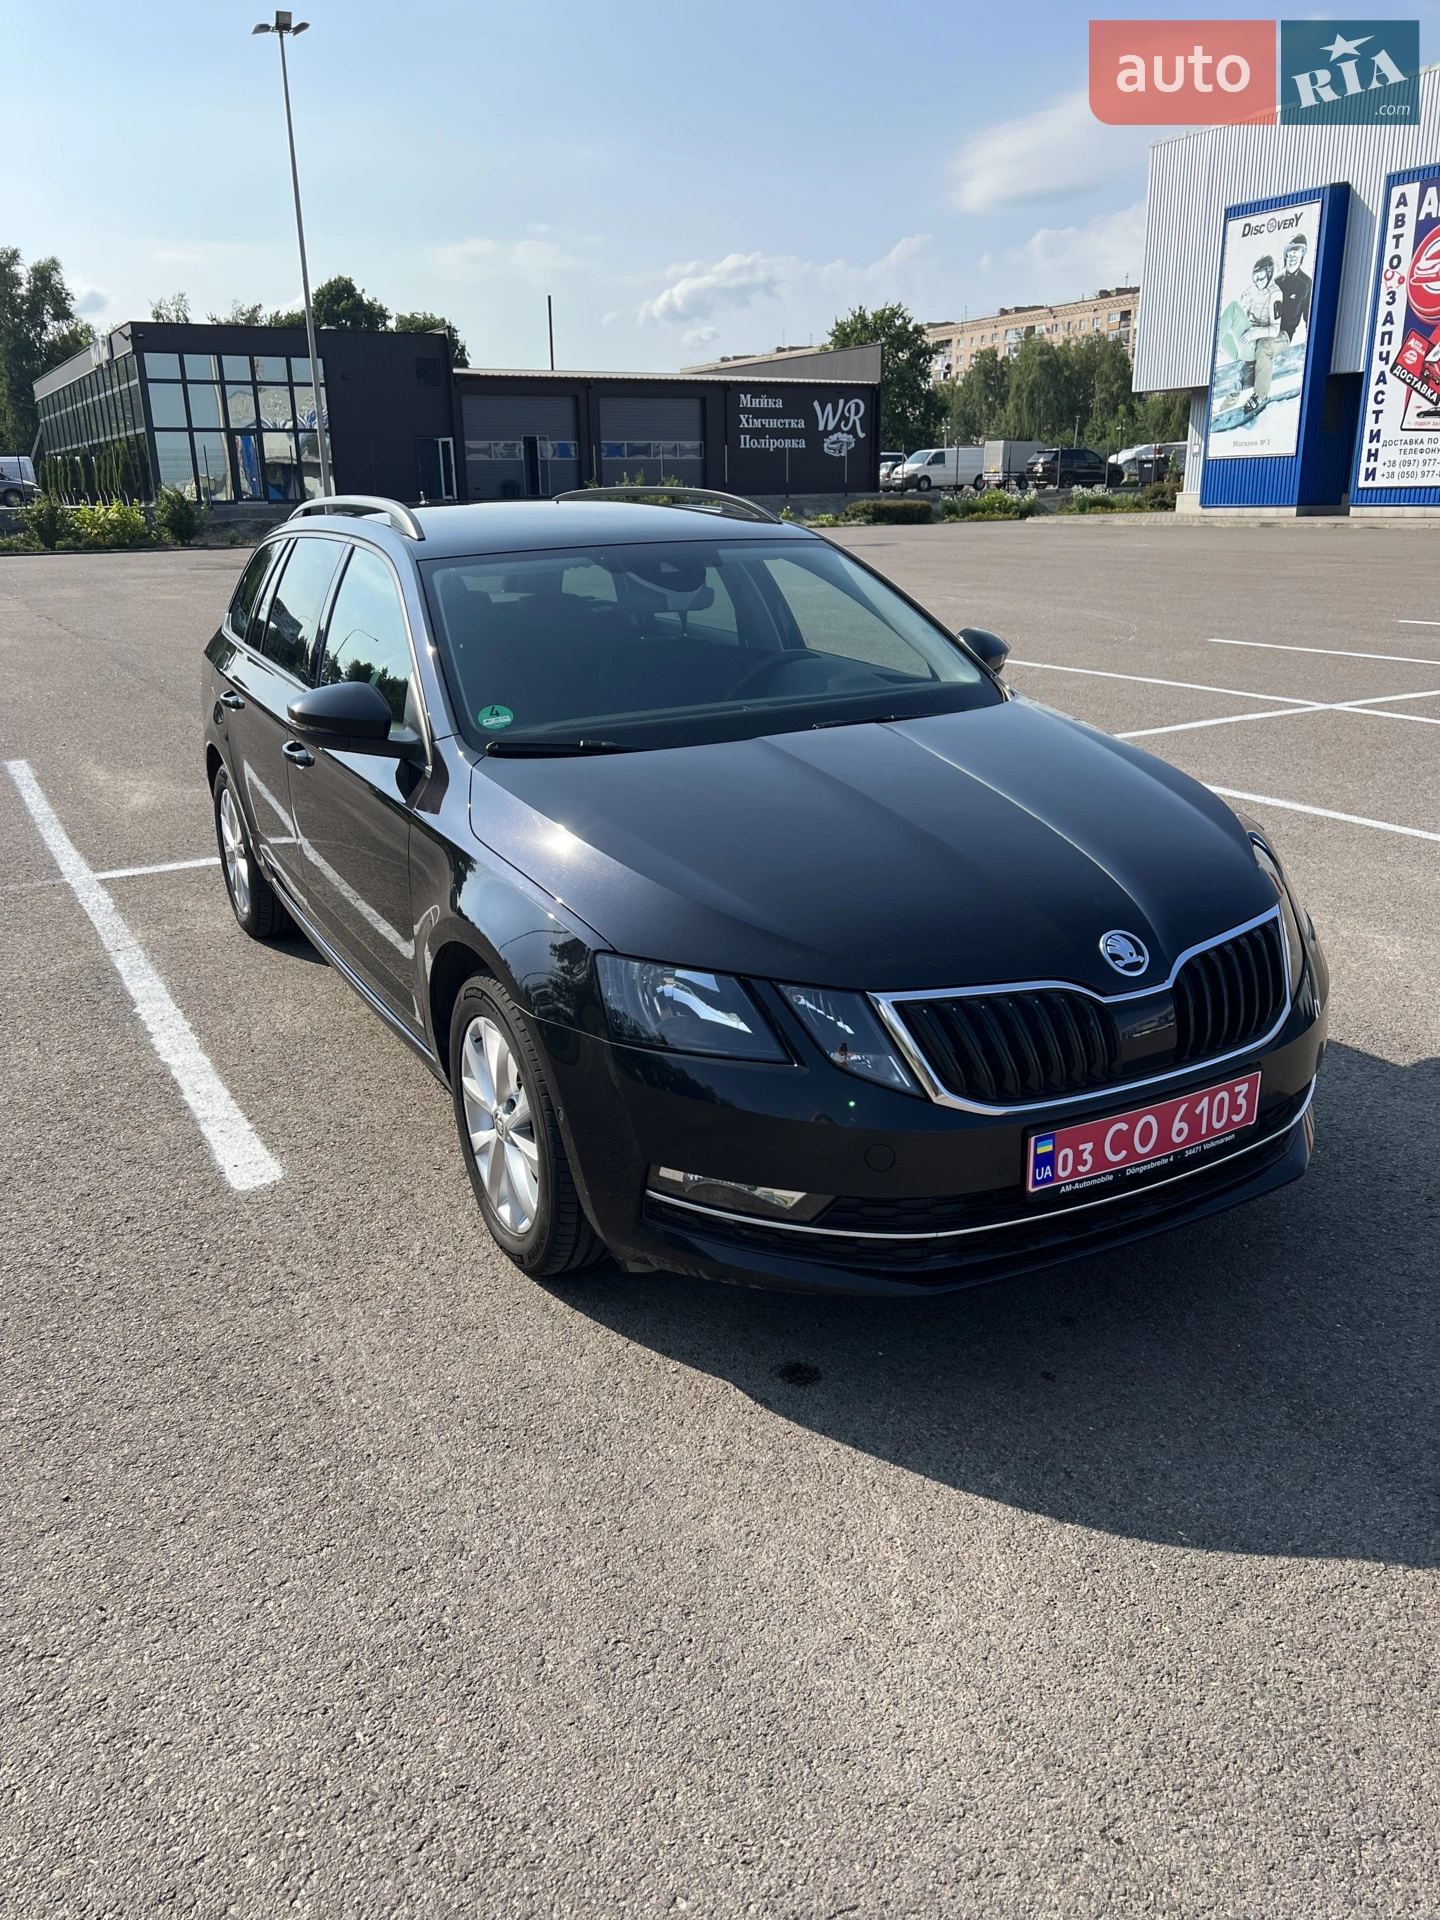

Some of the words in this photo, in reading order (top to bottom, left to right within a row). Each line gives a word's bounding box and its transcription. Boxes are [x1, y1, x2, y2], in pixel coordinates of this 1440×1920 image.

[1393, 365, 1438, 403] ДОСТАВКА
[739, 393, 783, 408] Мийка
[739, 414, 805, 429] Хімчистка
[812, 398, 866, 439] WR
[740, 434, 806, 452] Поліровка
[1382, 438, 1424, 448] ДОСТАВКА
[1427, 437, 1439, 445] ПО
[1382, 460, 1397, 468] +38
[1398, 459, 1420, 469] (097)
[1380, 471, 1395, 479] +38
[1397, 470, 1418, 480] (050)
[490, 706, 499, 716] 4
[1057, 1141, 1093, 1178] 03
[1104, 1114, 1159, 1162] CO
[1171, 1082, 1249, 1144] 6103
[1060, 1173, 1114, 1193] AM-Automobile
[1126, 1157, 1169, 1176] Döngesbreite
[1184, 1145, 1202, 1158] 34471
[1202, 1133, 1235, 1152] Volkmarsen
[1035, 1167, 1052, 1181] UA
